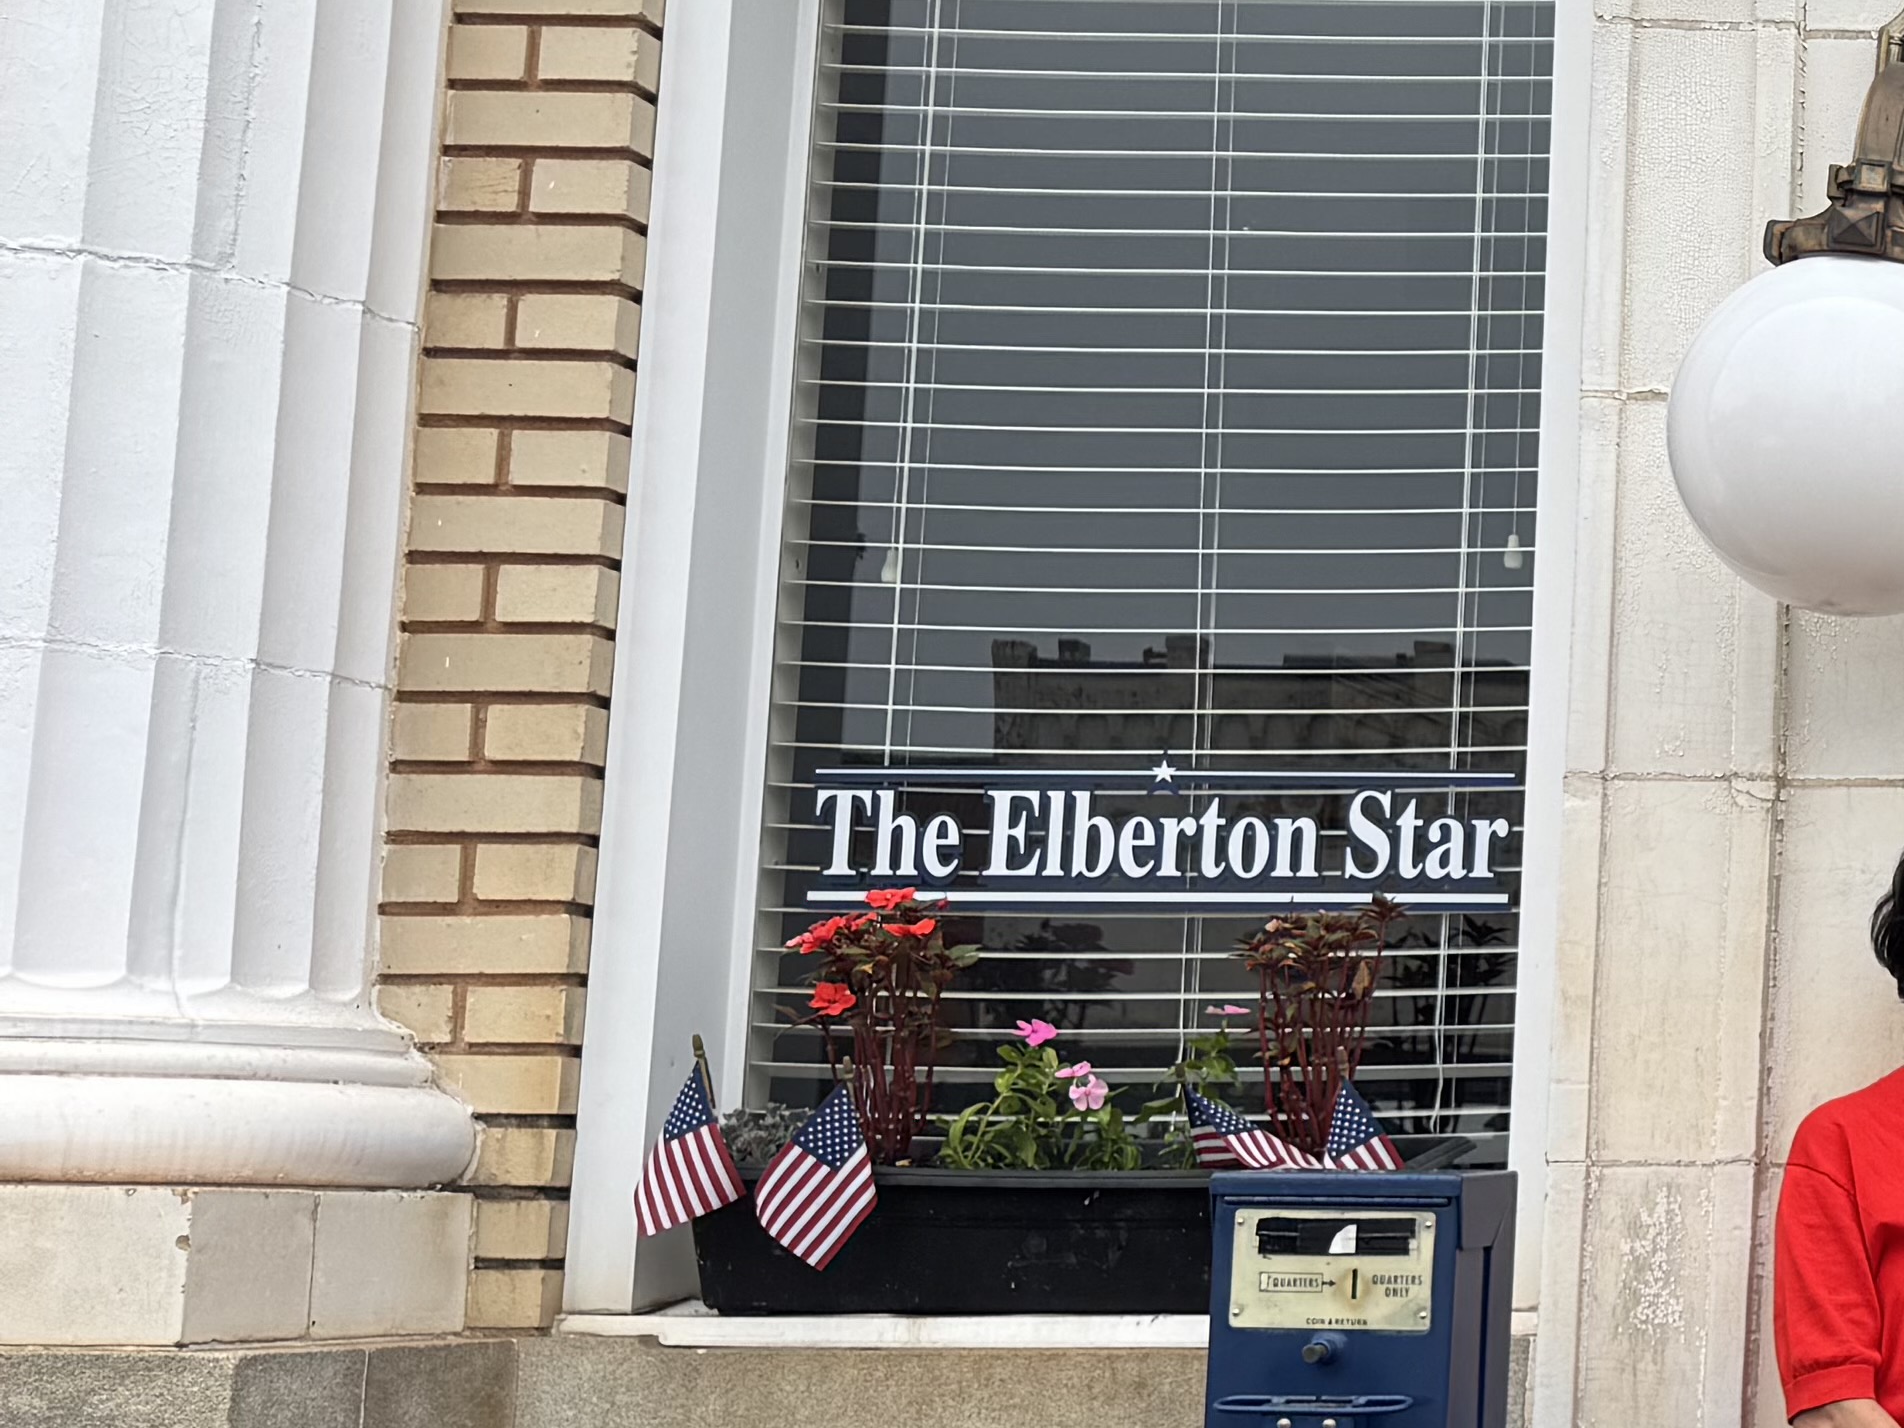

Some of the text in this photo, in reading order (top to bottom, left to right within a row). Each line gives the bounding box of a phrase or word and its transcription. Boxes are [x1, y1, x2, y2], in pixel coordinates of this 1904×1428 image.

[815, 787, 1510, 883] The Elberton Star
[1273, 1276, 1319, 1288] QUARTERS
[1372, 1274, 1423, 1286] QUARTERS
[1385, 1287, 1410, 1297] ONLY
[1306, 1317, 1368, 1326] COIN RETURN
